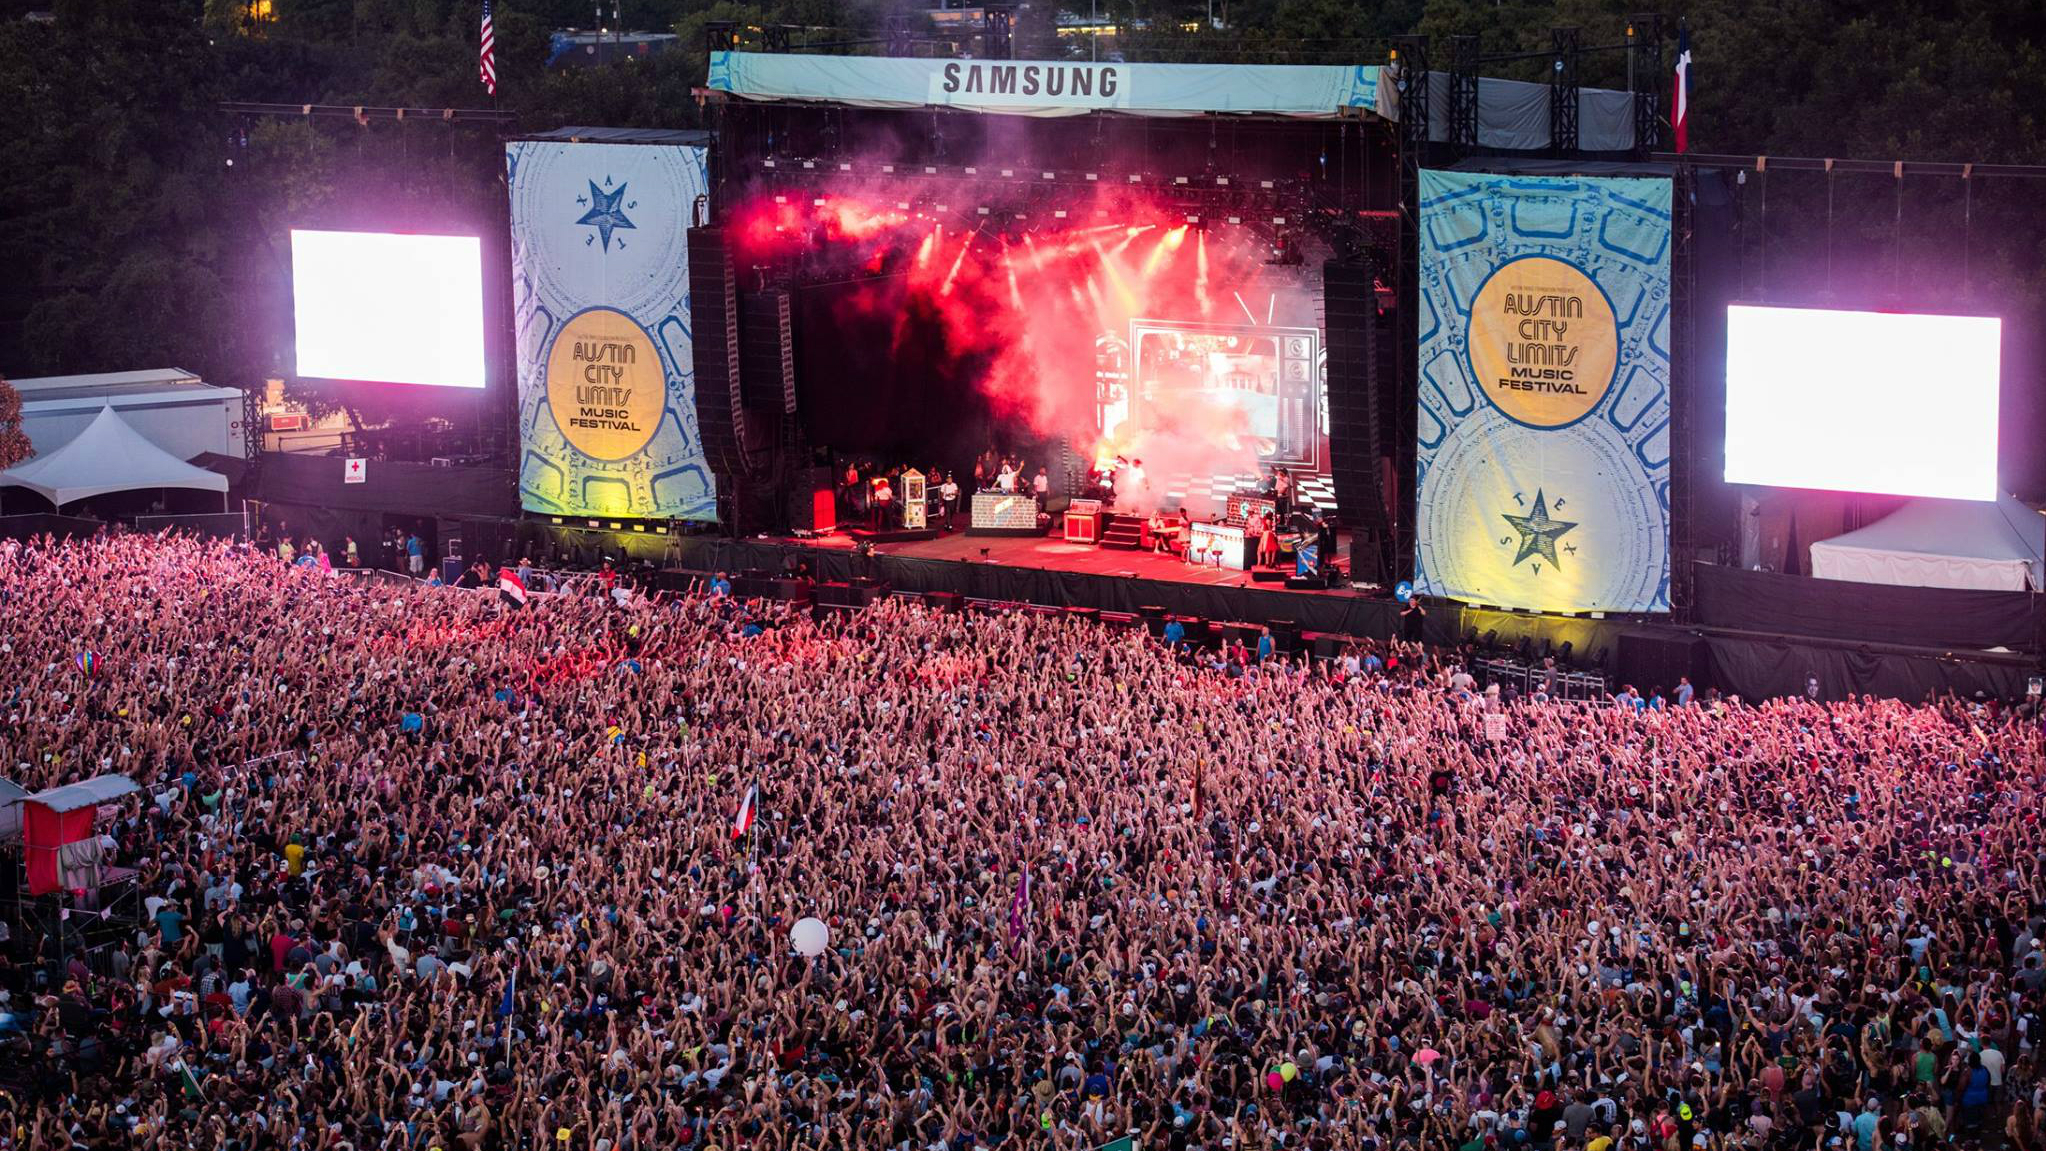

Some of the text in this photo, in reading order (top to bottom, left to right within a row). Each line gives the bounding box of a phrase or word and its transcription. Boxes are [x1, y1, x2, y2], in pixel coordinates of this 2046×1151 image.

[943, 62, 1117, 97] SAMSUNG
[1504, 293, 1583, 319] AUSTIN
[1518, 318, 1568, 342] CITY
[572, 341, 636, 363] AUSTIN
[1507, 342, 1579, 366] LIMITS
[584, 364, 624, 385] CITY
[1511, 367, 1574, 380] MUSIC
[576, 385, 632, 406] LIMITS
[1498, 378, 1587, 395] FESTIVAL
[580, 407, 629, 419] MUSIC
[570, 418, 641, 432] FESTIVAL
